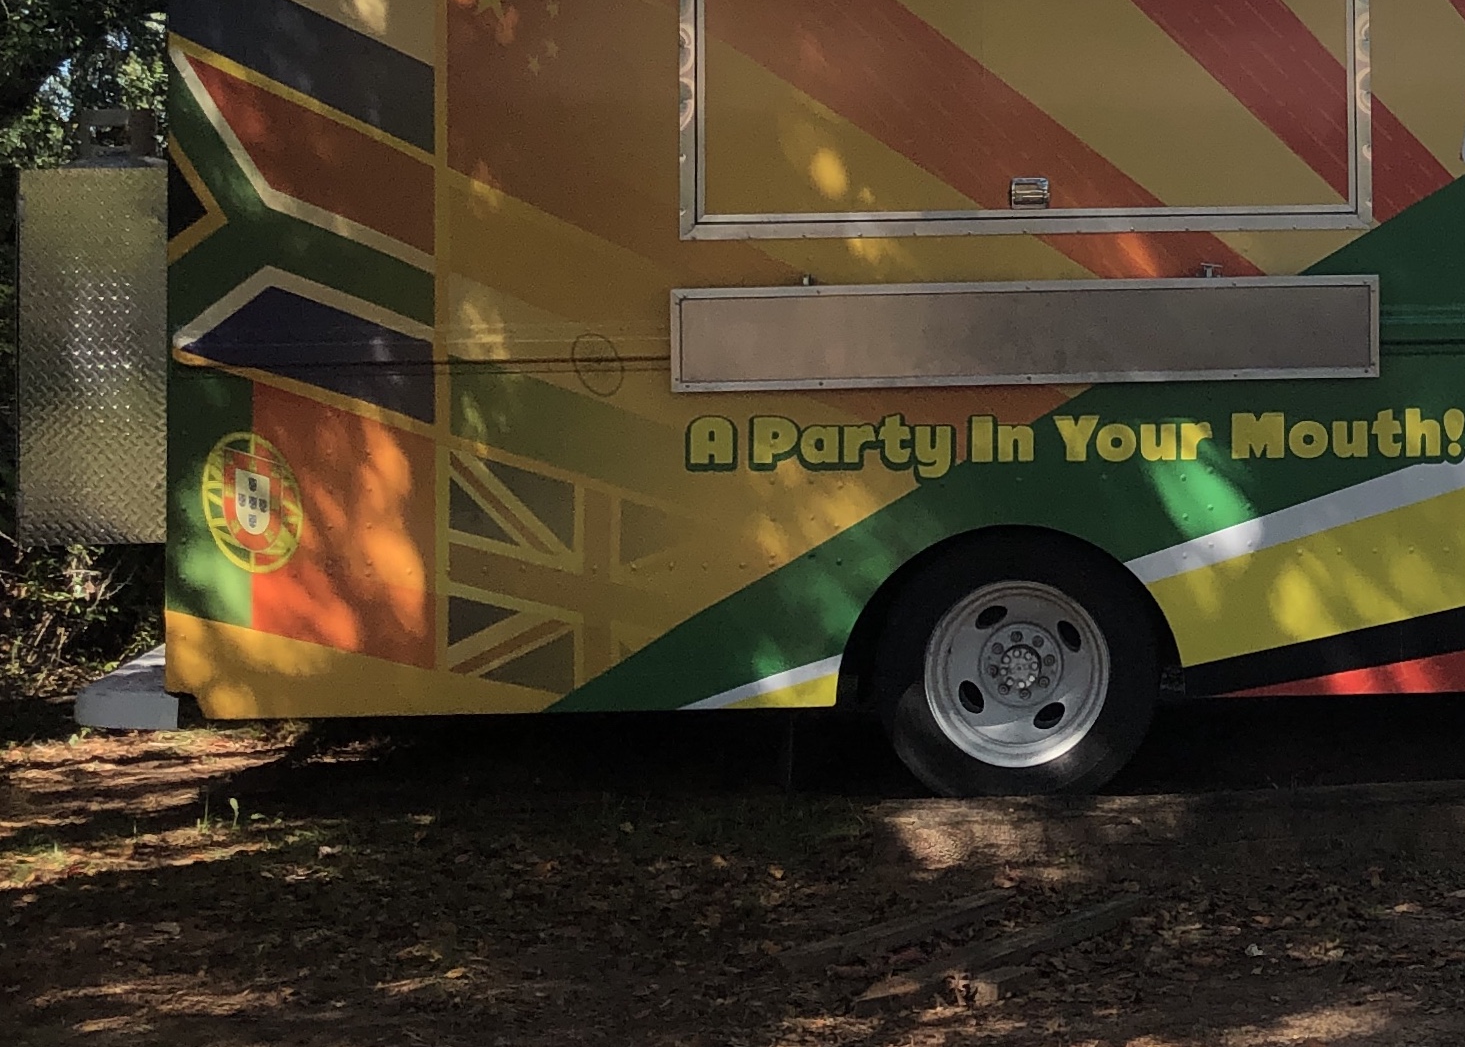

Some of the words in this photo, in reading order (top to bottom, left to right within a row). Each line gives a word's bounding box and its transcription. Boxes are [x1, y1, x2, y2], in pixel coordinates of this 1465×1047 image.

[689, 415, 735, 465] A
[753, 414, 952, 479] Party
[971, 415, 1035, 463] In
[1054, 415, 1212, 463] Your
[1229, 408, 1465, 460] Mouth!
